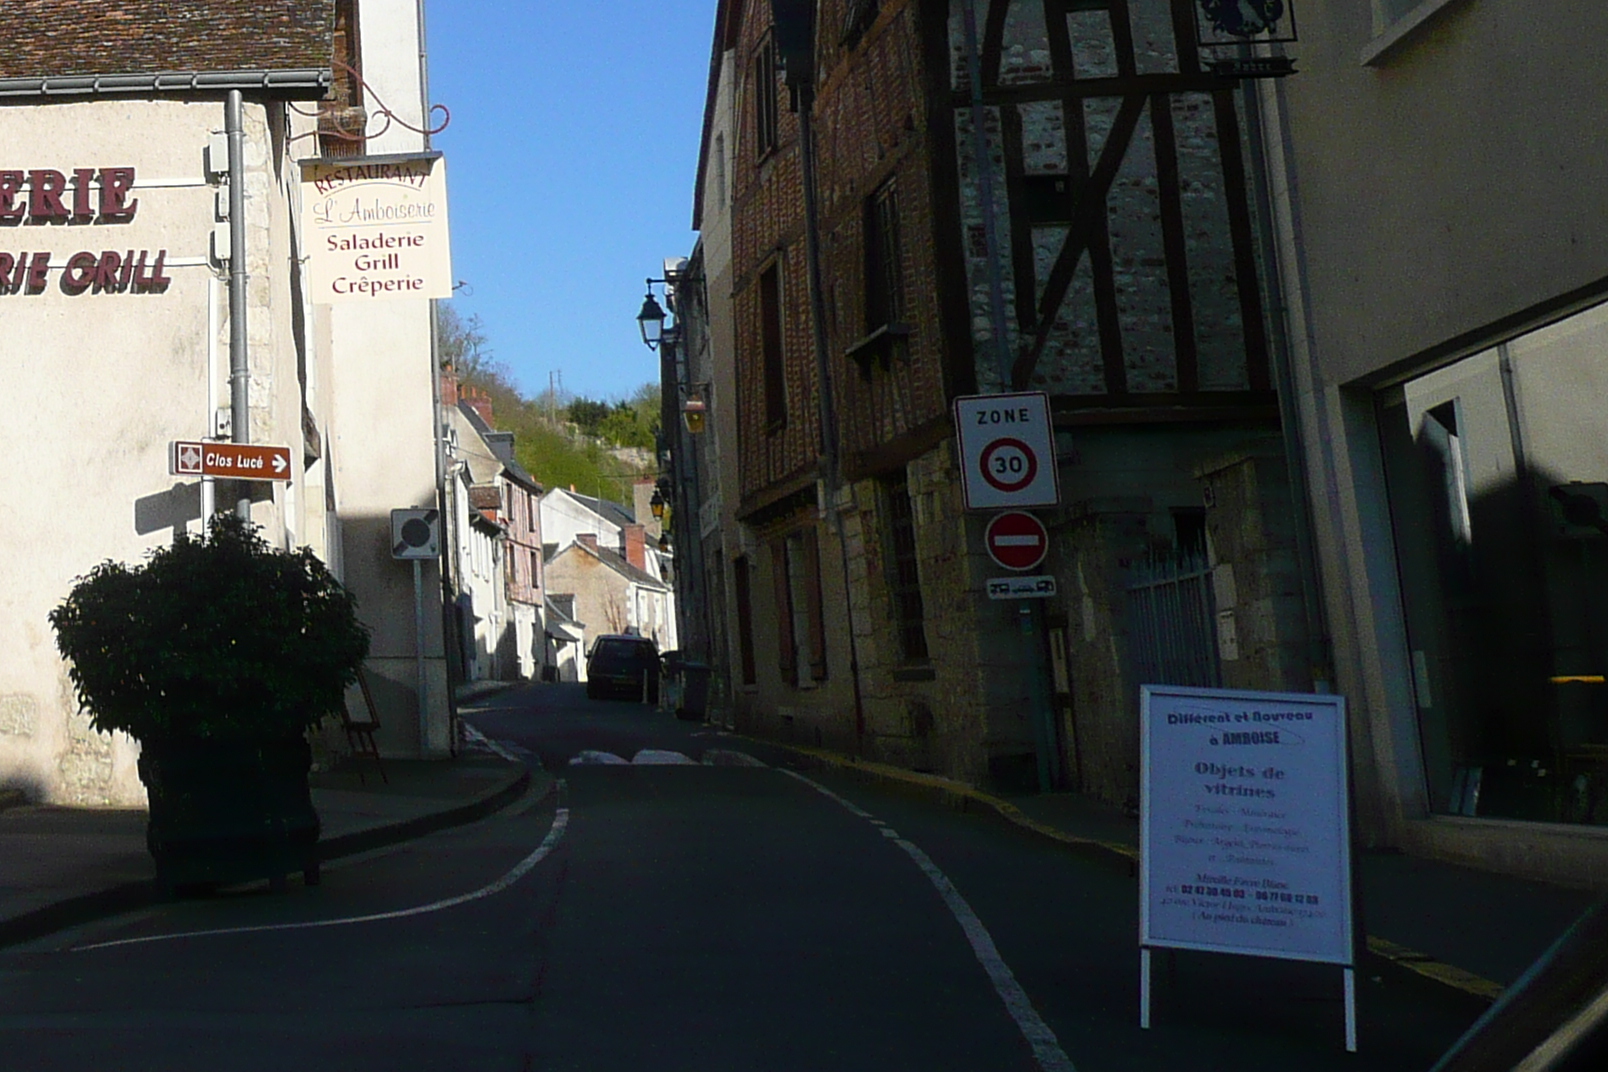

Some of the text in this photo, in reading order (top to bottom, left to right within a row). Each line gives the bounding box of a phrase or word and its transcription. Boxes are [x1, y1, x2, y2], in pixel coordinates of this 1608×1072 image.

[314, 164, 429, 195] RESTAURANT
[327, 232, 425, 251] Saladerie
[355, 253, 399, 271] Grill
[60, 249, 173, 297] GRILL
[332, 274, 424, 297] Crêperie
[977, 408, 1030, 425] ZONE
[206, 453, 263, 469] Clos Lucé
[994, 456, 1023, 474] 30
[1234, 711, 1248, 723] et
[1222, 731, 1280, 746] AMBOISE
[1194, 762, 1285, 780] Objets de
[1204, 784, 1276, 798] vitrines
